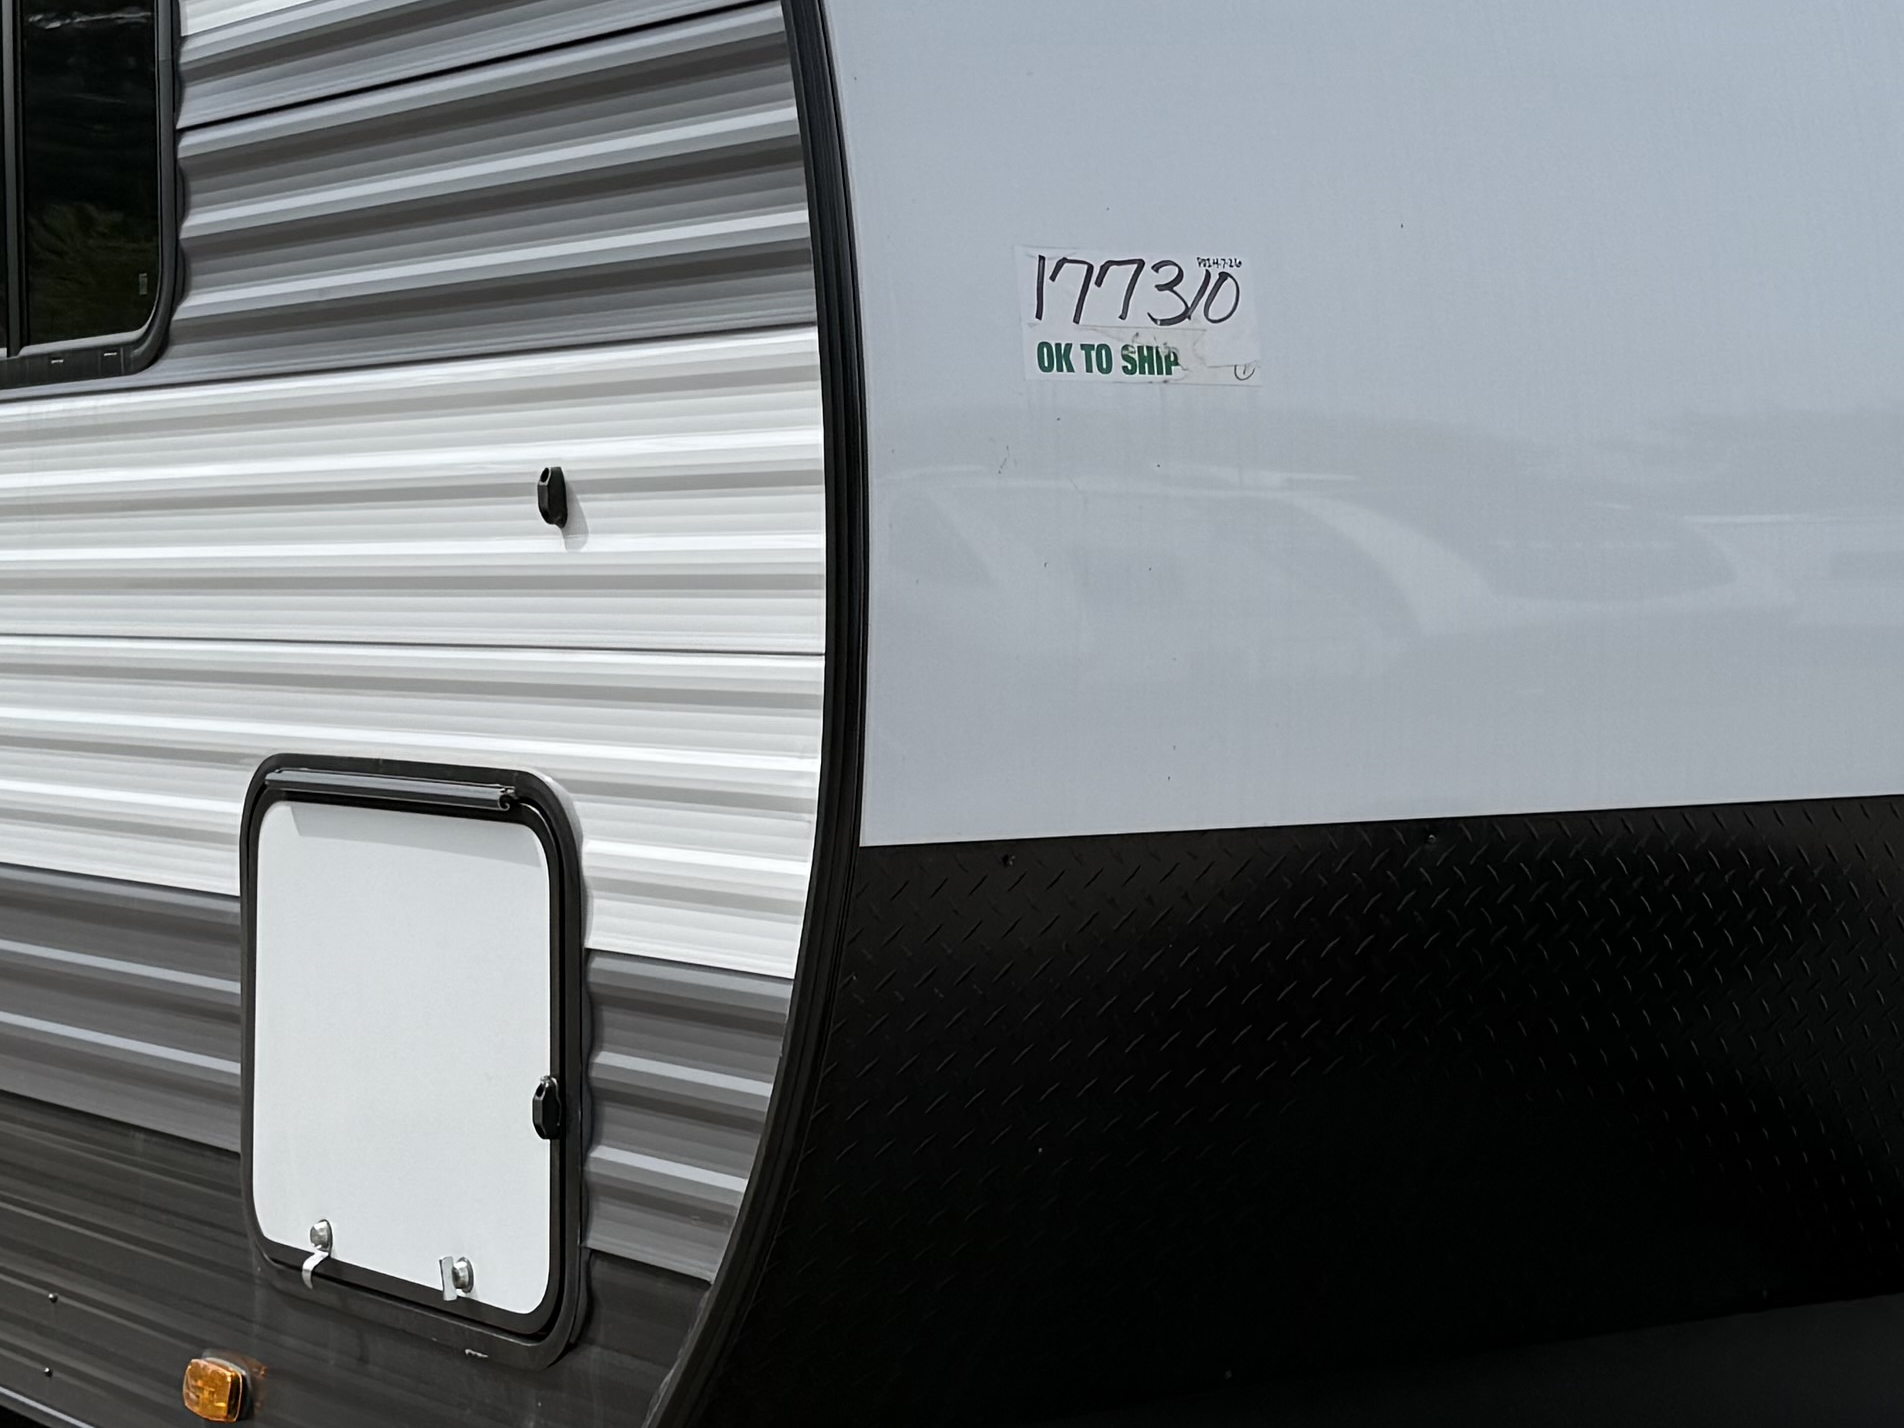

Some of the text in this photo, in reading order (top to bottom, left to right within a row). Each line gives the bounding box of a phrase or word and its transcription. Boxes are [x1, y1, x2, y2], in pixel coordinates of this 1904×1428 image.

[1036, 340, 1180, 377] OK TO SHIP
